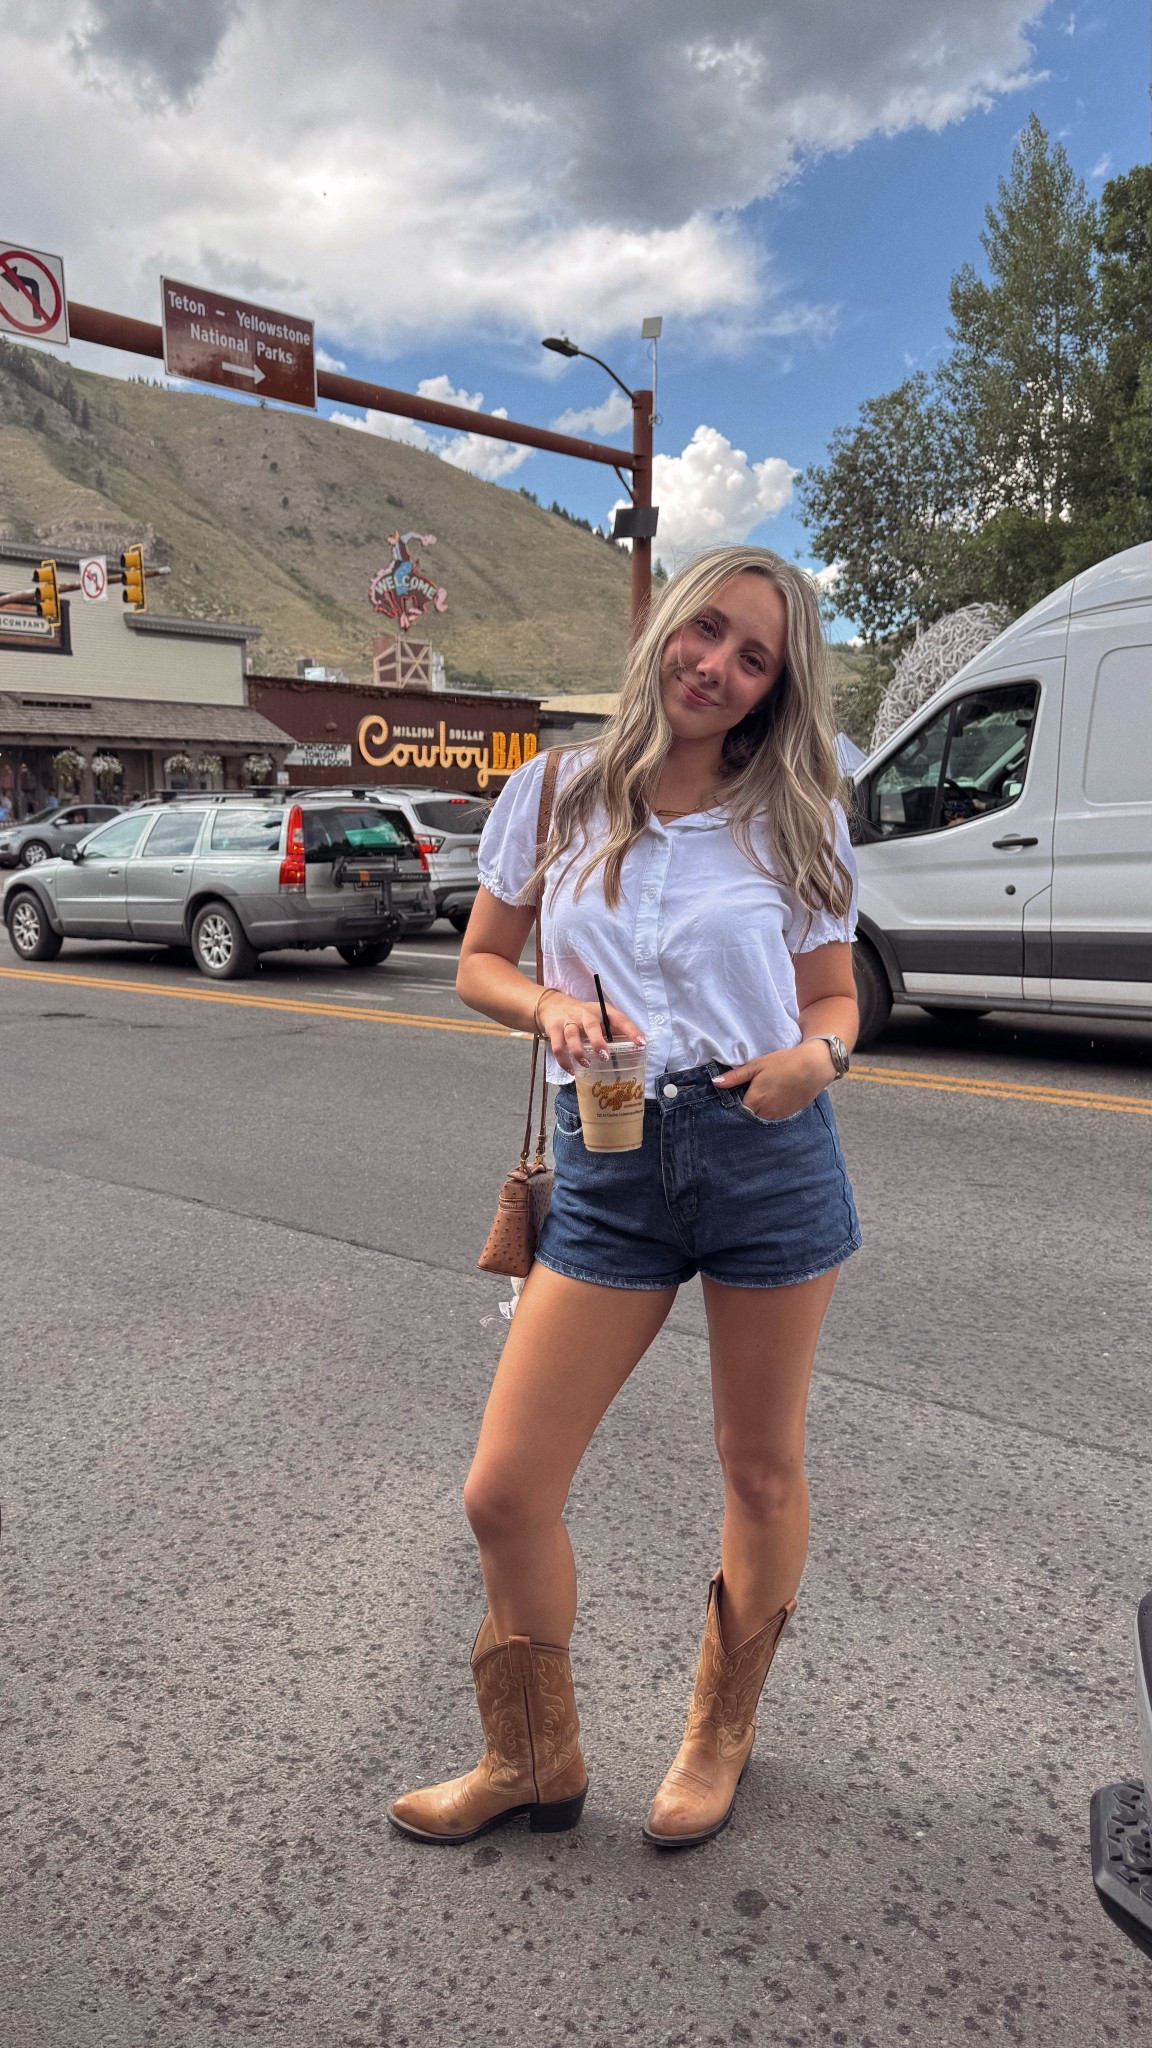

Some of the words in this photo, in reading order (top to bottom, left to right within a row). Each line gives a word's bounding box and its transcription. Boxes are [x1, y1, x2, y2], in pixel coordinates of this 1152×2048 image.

[168, 290, 206, 317] Teton
[236, 309, 311, 346] Yellowstone
[190, 322, 249, 354] National
[256, 340, 293, 365] Parks
[374, 575, 437, 600] WELCOME
[2, 617, 46, 630] COMPANY
[392, 725, 435, 739] MILLION
[450, 728, 485, 742] DOLLAR
[305, 751, 338, 759] TONIGHT
[358, 714, 489, 789] Cowboy
[492, 731, 538, 769] BAR
